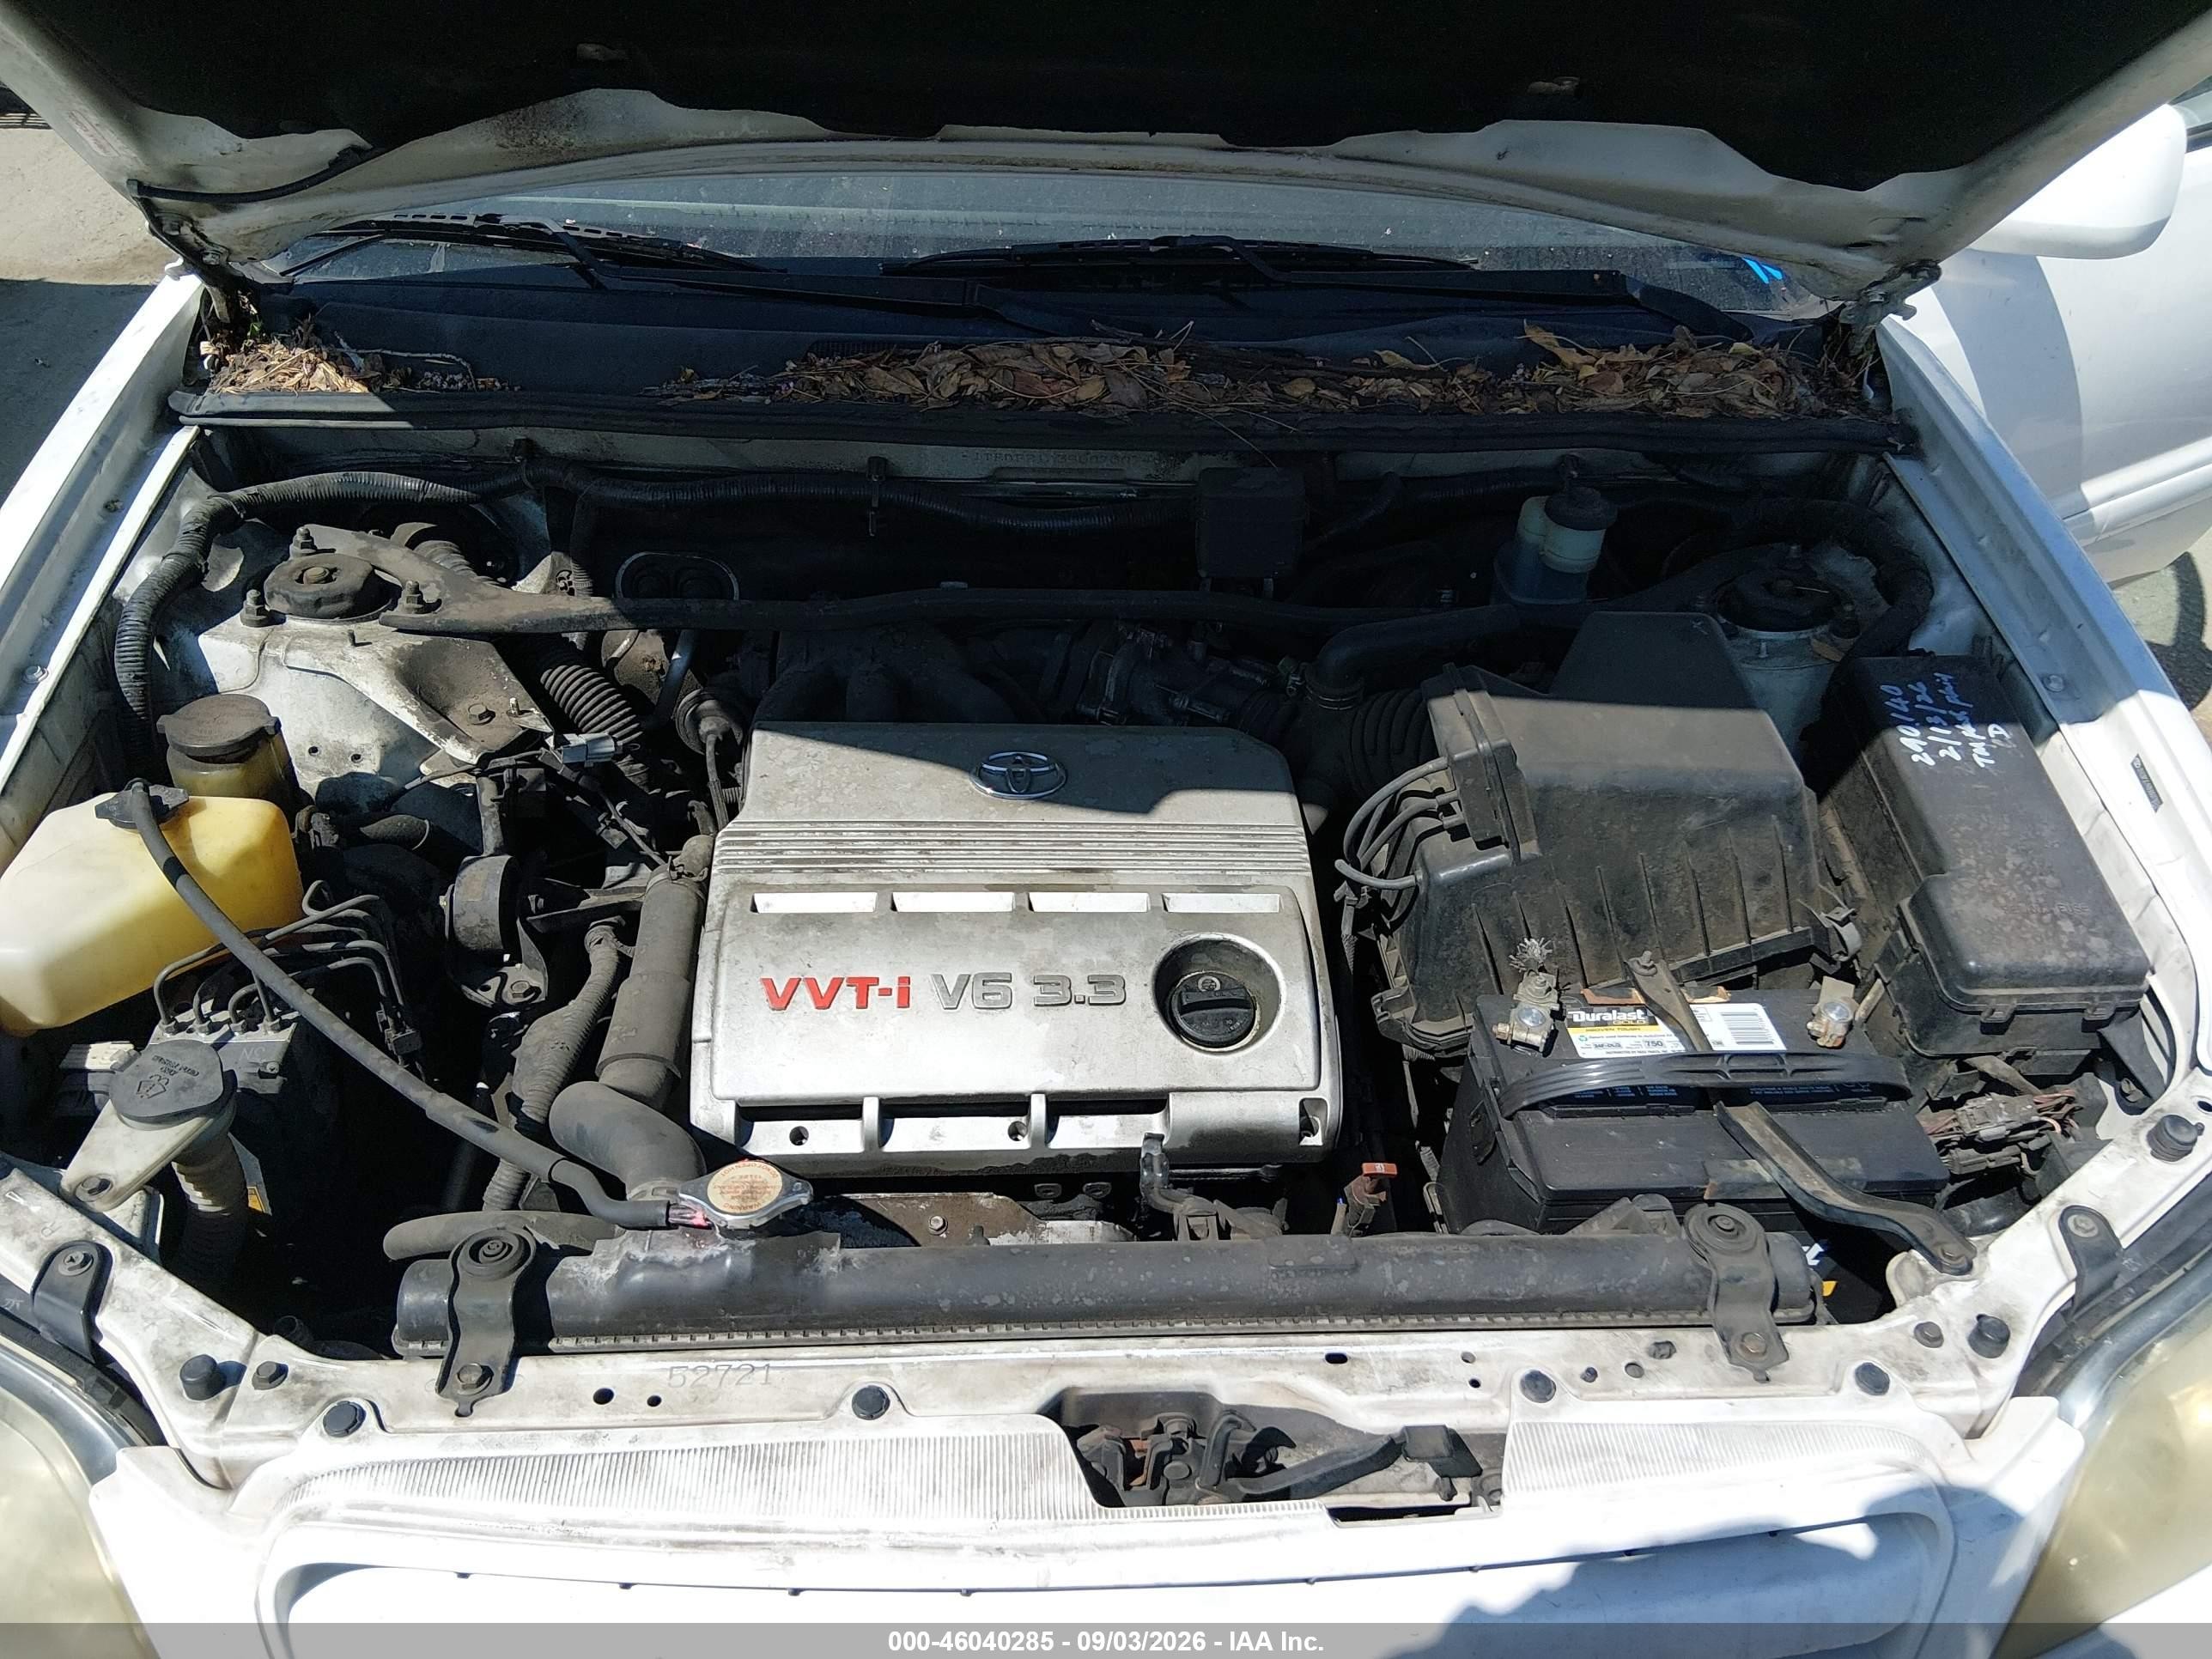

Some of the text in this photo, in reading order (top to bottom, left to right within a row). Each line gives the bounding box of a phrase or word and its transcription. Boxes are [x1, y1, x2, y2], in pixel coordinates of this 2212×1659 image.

[760, 971, 1128, 1012] VVT-i V6 3.3
[1567, 1009, 1646, 1023] Duralast
[666, 1362, 772, 1389] 52721
